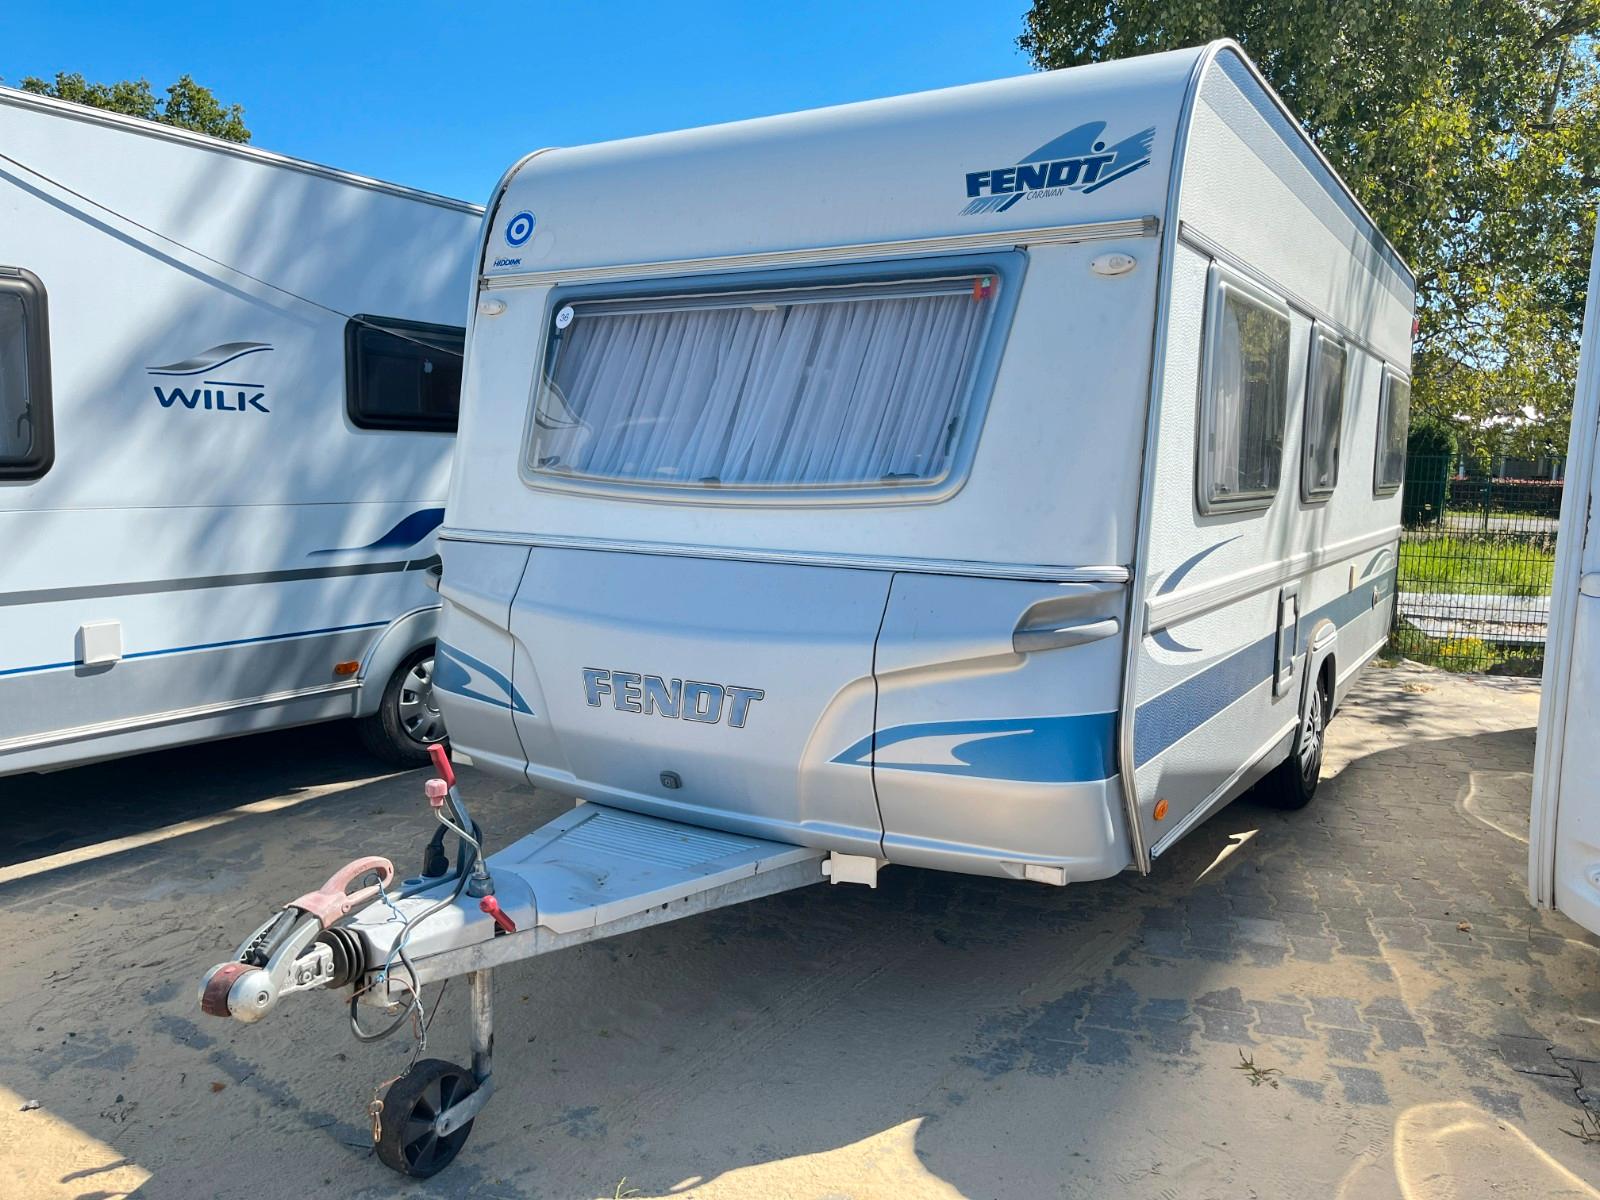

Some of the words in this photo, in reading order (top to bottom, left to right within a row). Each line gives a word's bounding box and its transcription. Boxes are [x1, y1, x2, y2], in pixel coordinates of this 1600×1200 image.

[965, 153, 1116, 198] FENDT
[1026, 188, 1065, 201] CARAVAN
[153, 386, 271, 413] WILK
[582, 666, 765, 729] FENDT
